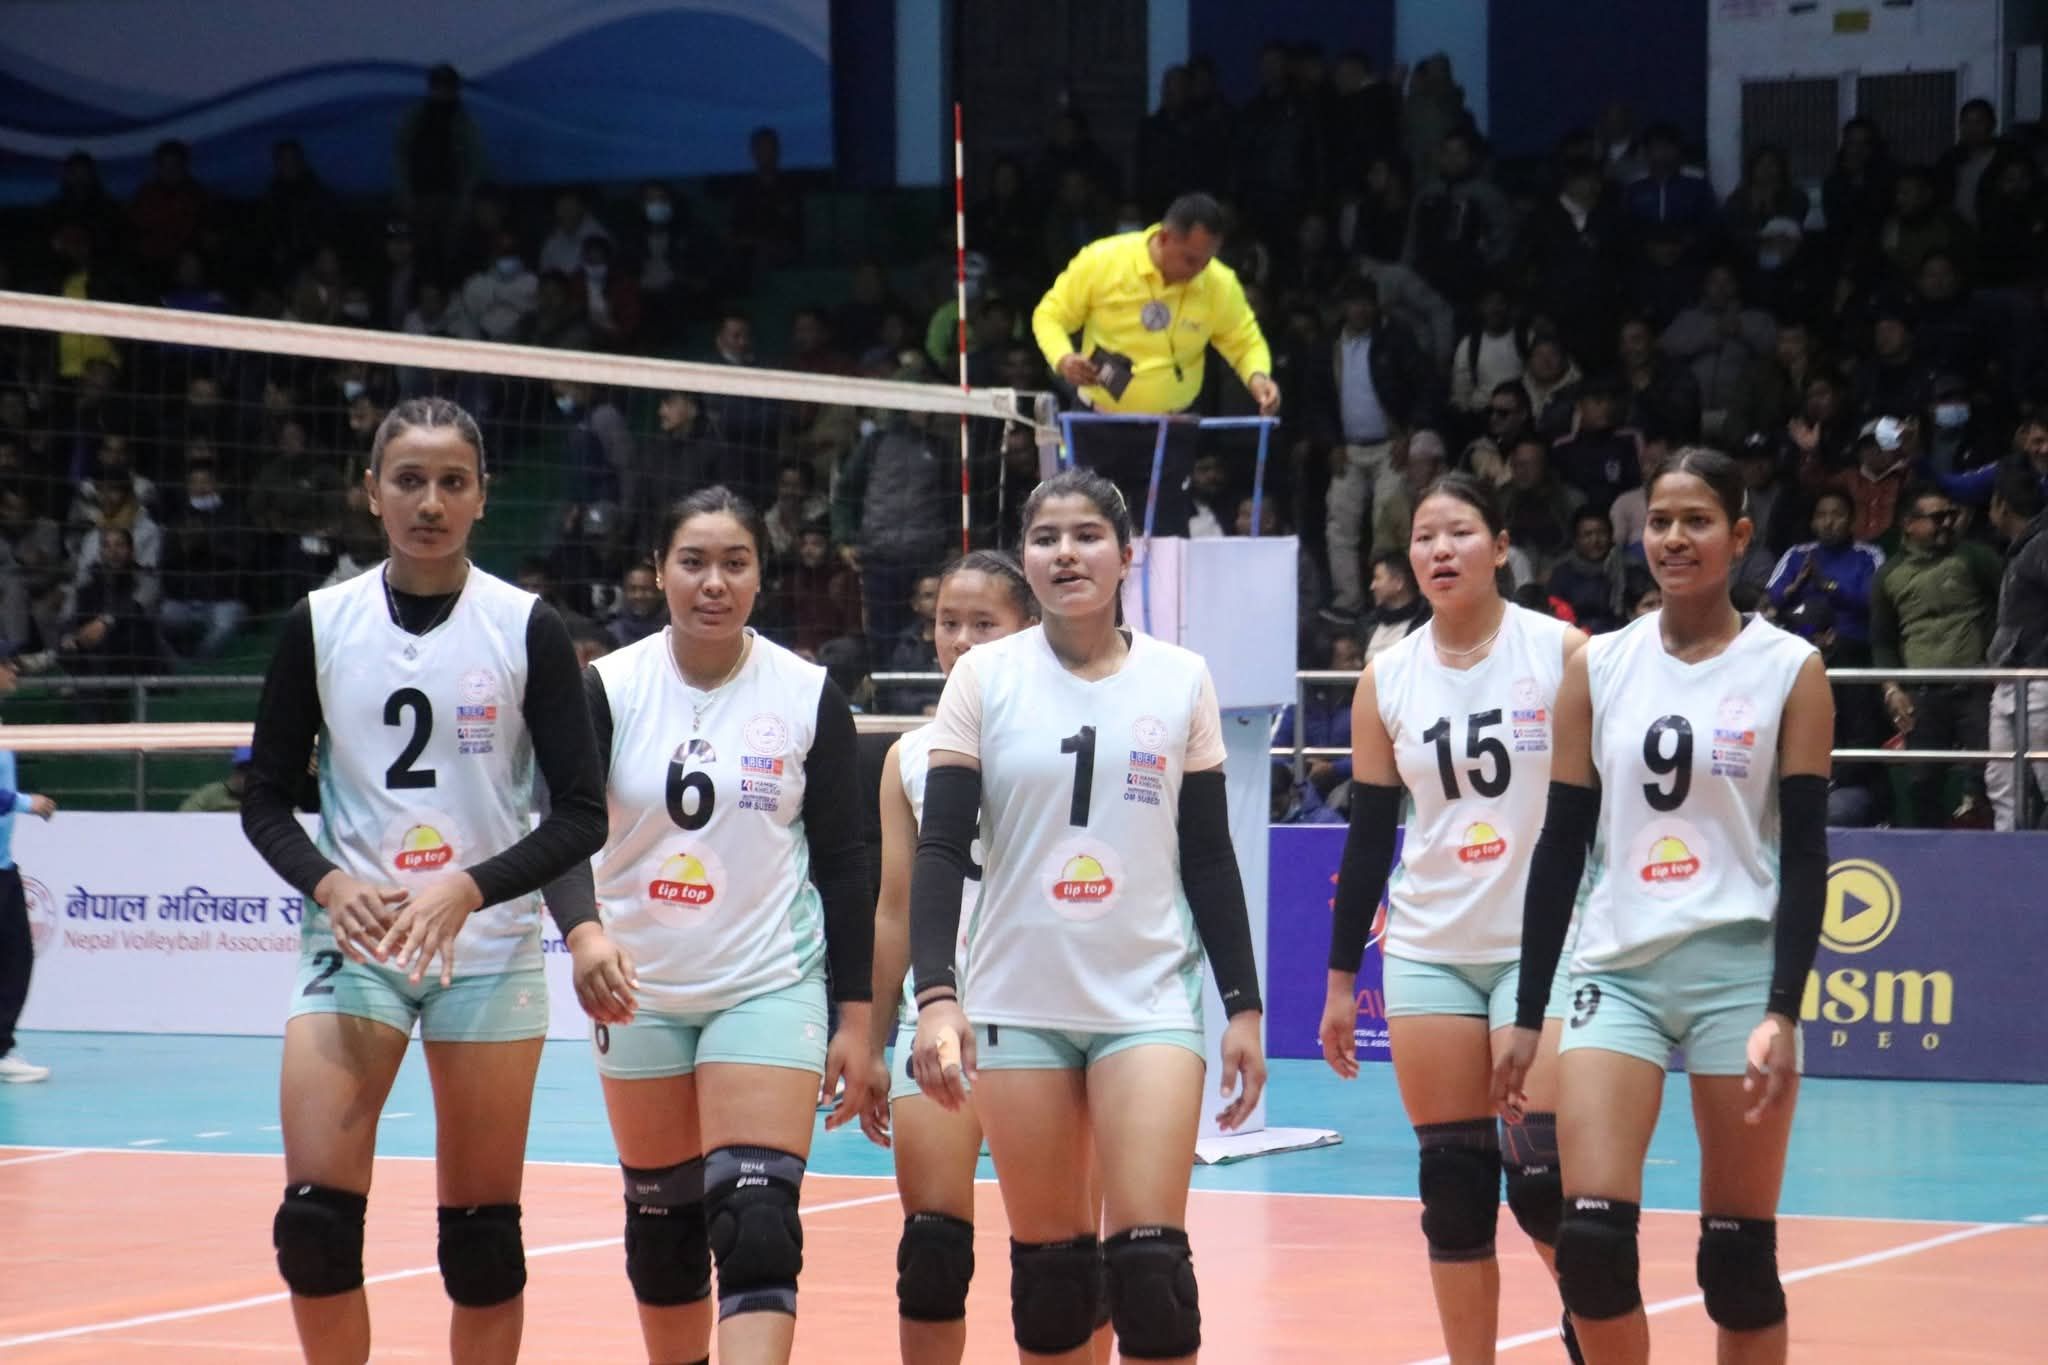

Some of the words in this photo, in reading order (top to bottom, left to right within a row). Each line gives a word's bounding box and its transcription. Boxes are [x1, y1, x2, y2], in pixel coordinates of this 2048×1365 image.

[383, 687, 436, 789] 2
[1422, 708, 1512, 801] 15
[741, 756, 773, 769] LBEF
[1060, 725, 1097, 828] 1
[1641, 714, 1695, 812] 9
[665, 738, 717, 832] 6
[404, 852, 423, 867] tip
[425, 849, 447, 865] top
[1651, 865, 1669, 880] tip
[1671, 862, 1694, 877] top
[64, 885, 150, 922] नेपाल
[657, 883, 678, 899] tip
[681, 885, 707, 902] top
[1063, 883, 1081, 898] tip
[1084, 881, 1106, 897] top
[63, 930, 116, 954] Nepal
[121, 929, 209, 955] Volleyball
[302, 948, 345, 997] 2
[1570, 983, 1601, 1030] 9
